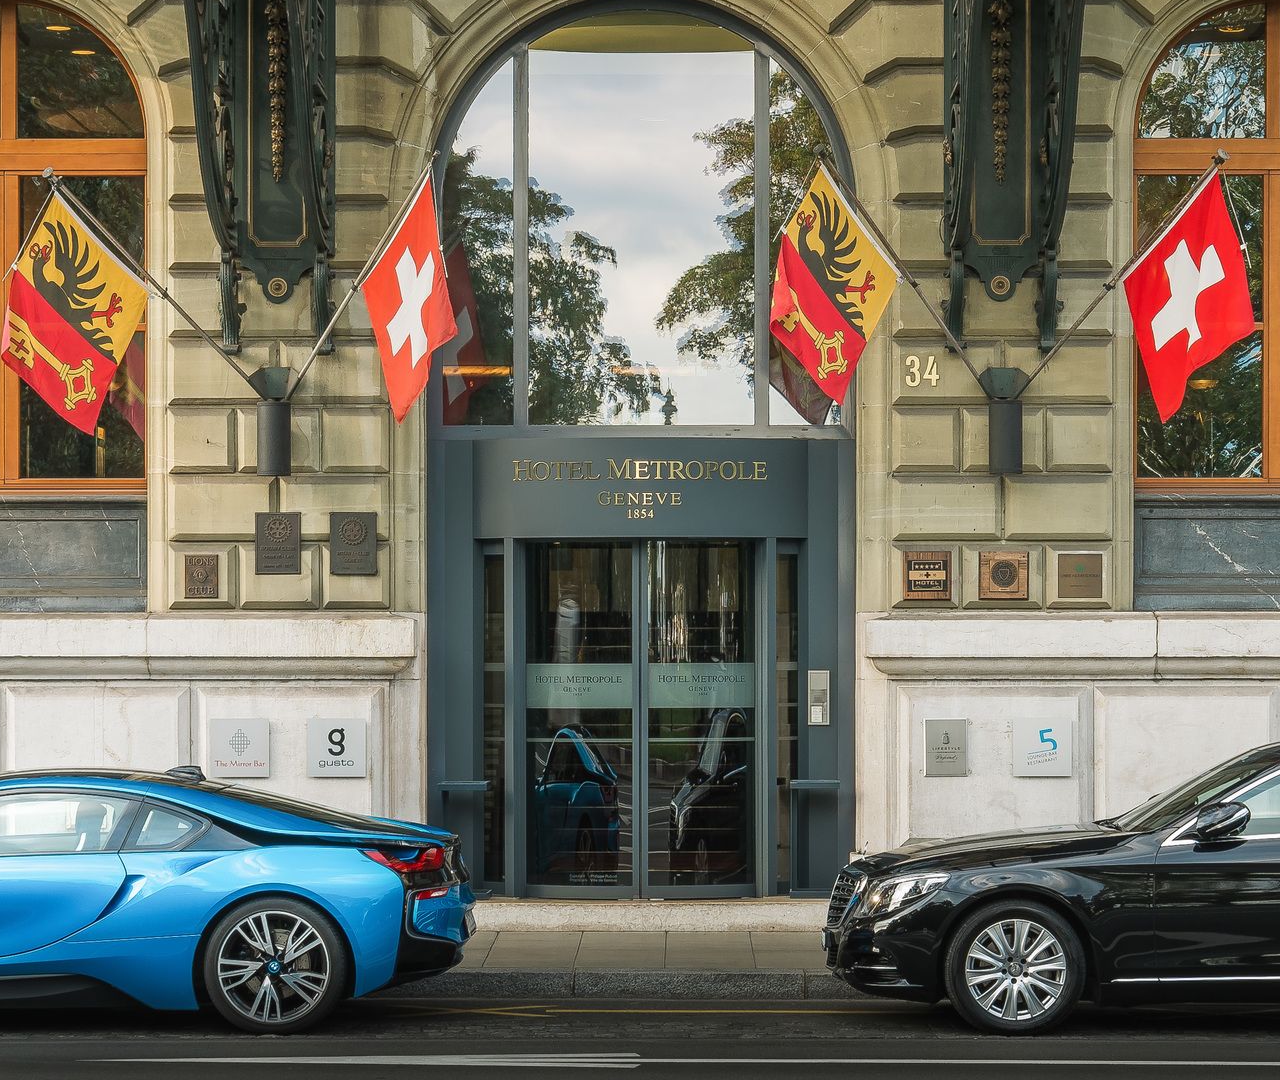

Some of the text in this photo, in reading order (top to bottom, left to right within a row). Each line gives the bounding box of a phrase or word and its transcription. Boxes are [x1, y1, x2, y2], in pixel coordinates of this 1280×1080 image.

[905, 355, 940, 387] 34
[512, 458, 769, 482] HOTEL METROPOLE
[598, 490, 682, 506] GENEVE
[626, 509, 655, 520] 1854
[187, 557, 215, 566] LIONS
[187, 586, 215, 595] CLUB
[535, 675, 622, 684] HOTEL METROPOLE
[658, 674, 746, 683] HOTEL METROPOLE
[1039, 728, 1058, 751] 5
[215, 760, 266, 768] The Mirror Bar
[318, 759, 355, 768] gusto
